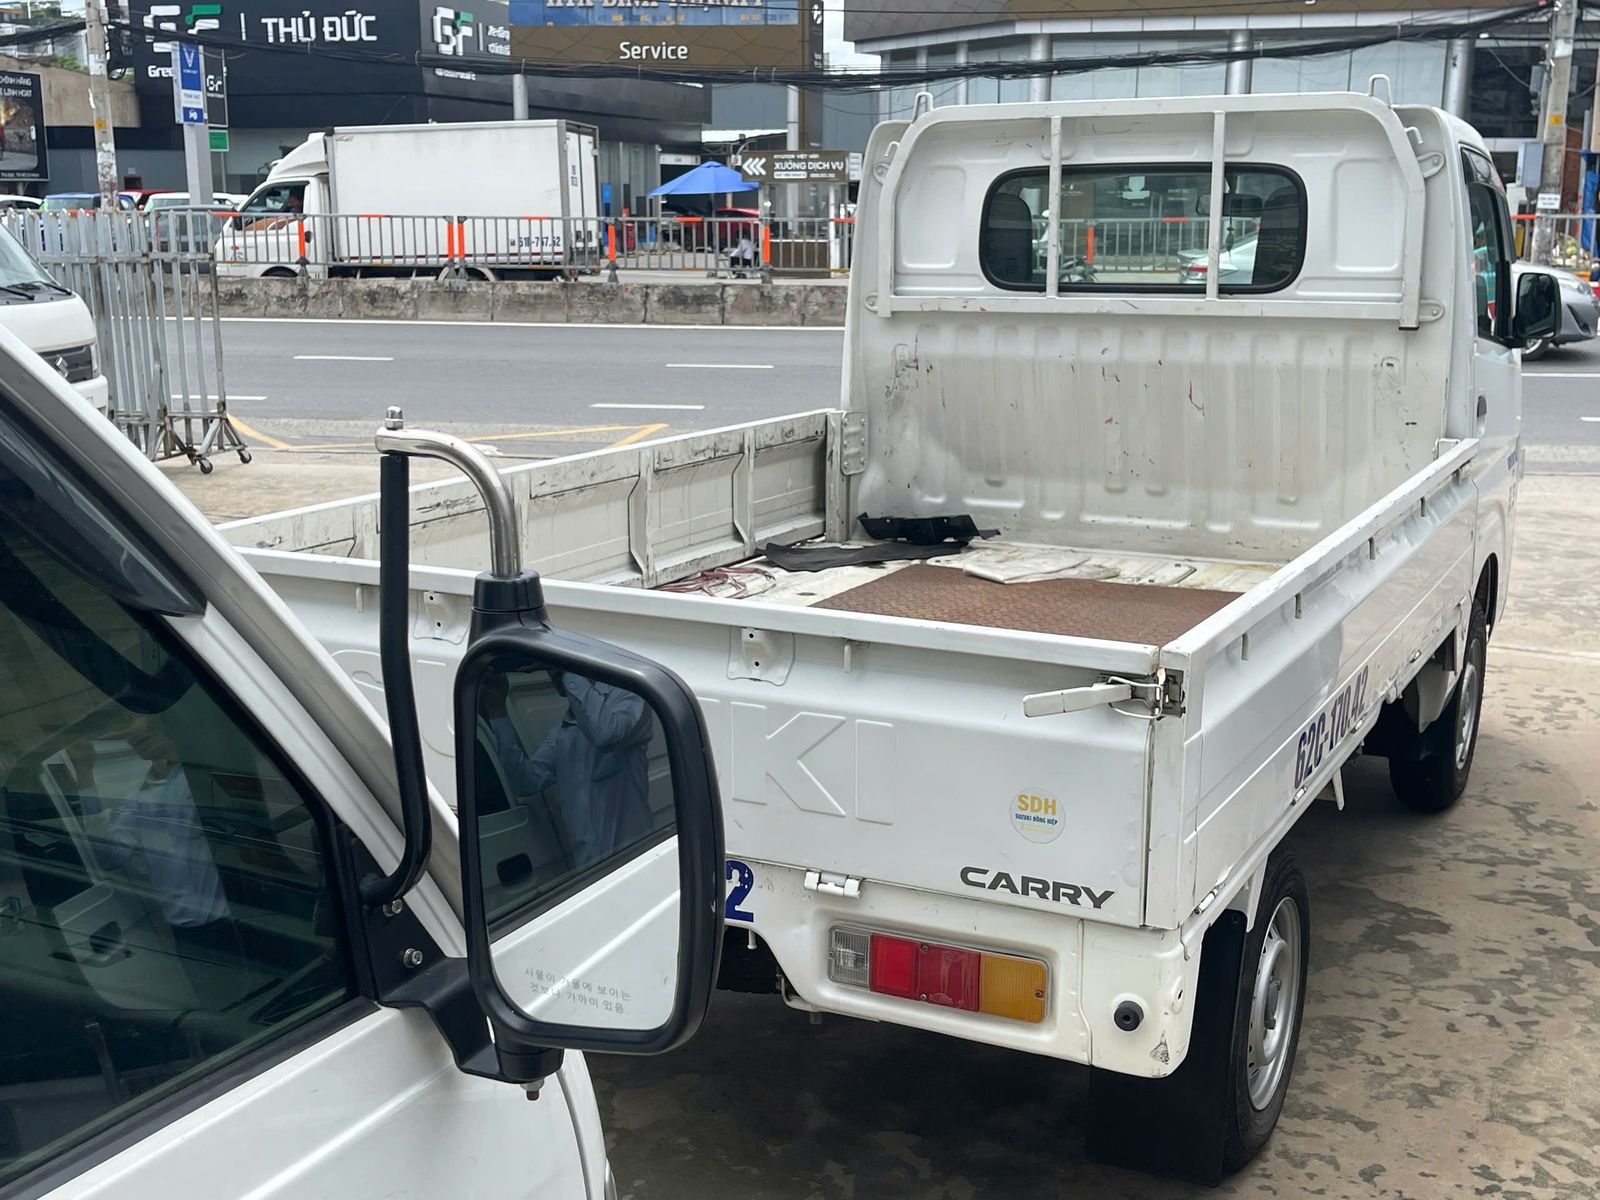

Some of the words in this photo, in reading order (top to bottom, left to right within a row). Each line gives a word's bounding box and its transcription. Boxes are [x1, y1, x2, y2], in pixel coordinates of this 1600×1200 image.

[261, 10, 316, 43] THỦ
[322, 10, 377, 41] ĐỨC
[619, 41, 688, 59] Service
[1017, 794, 1057, 816] SDH
[960, 866, 1115, 909] CARRY
